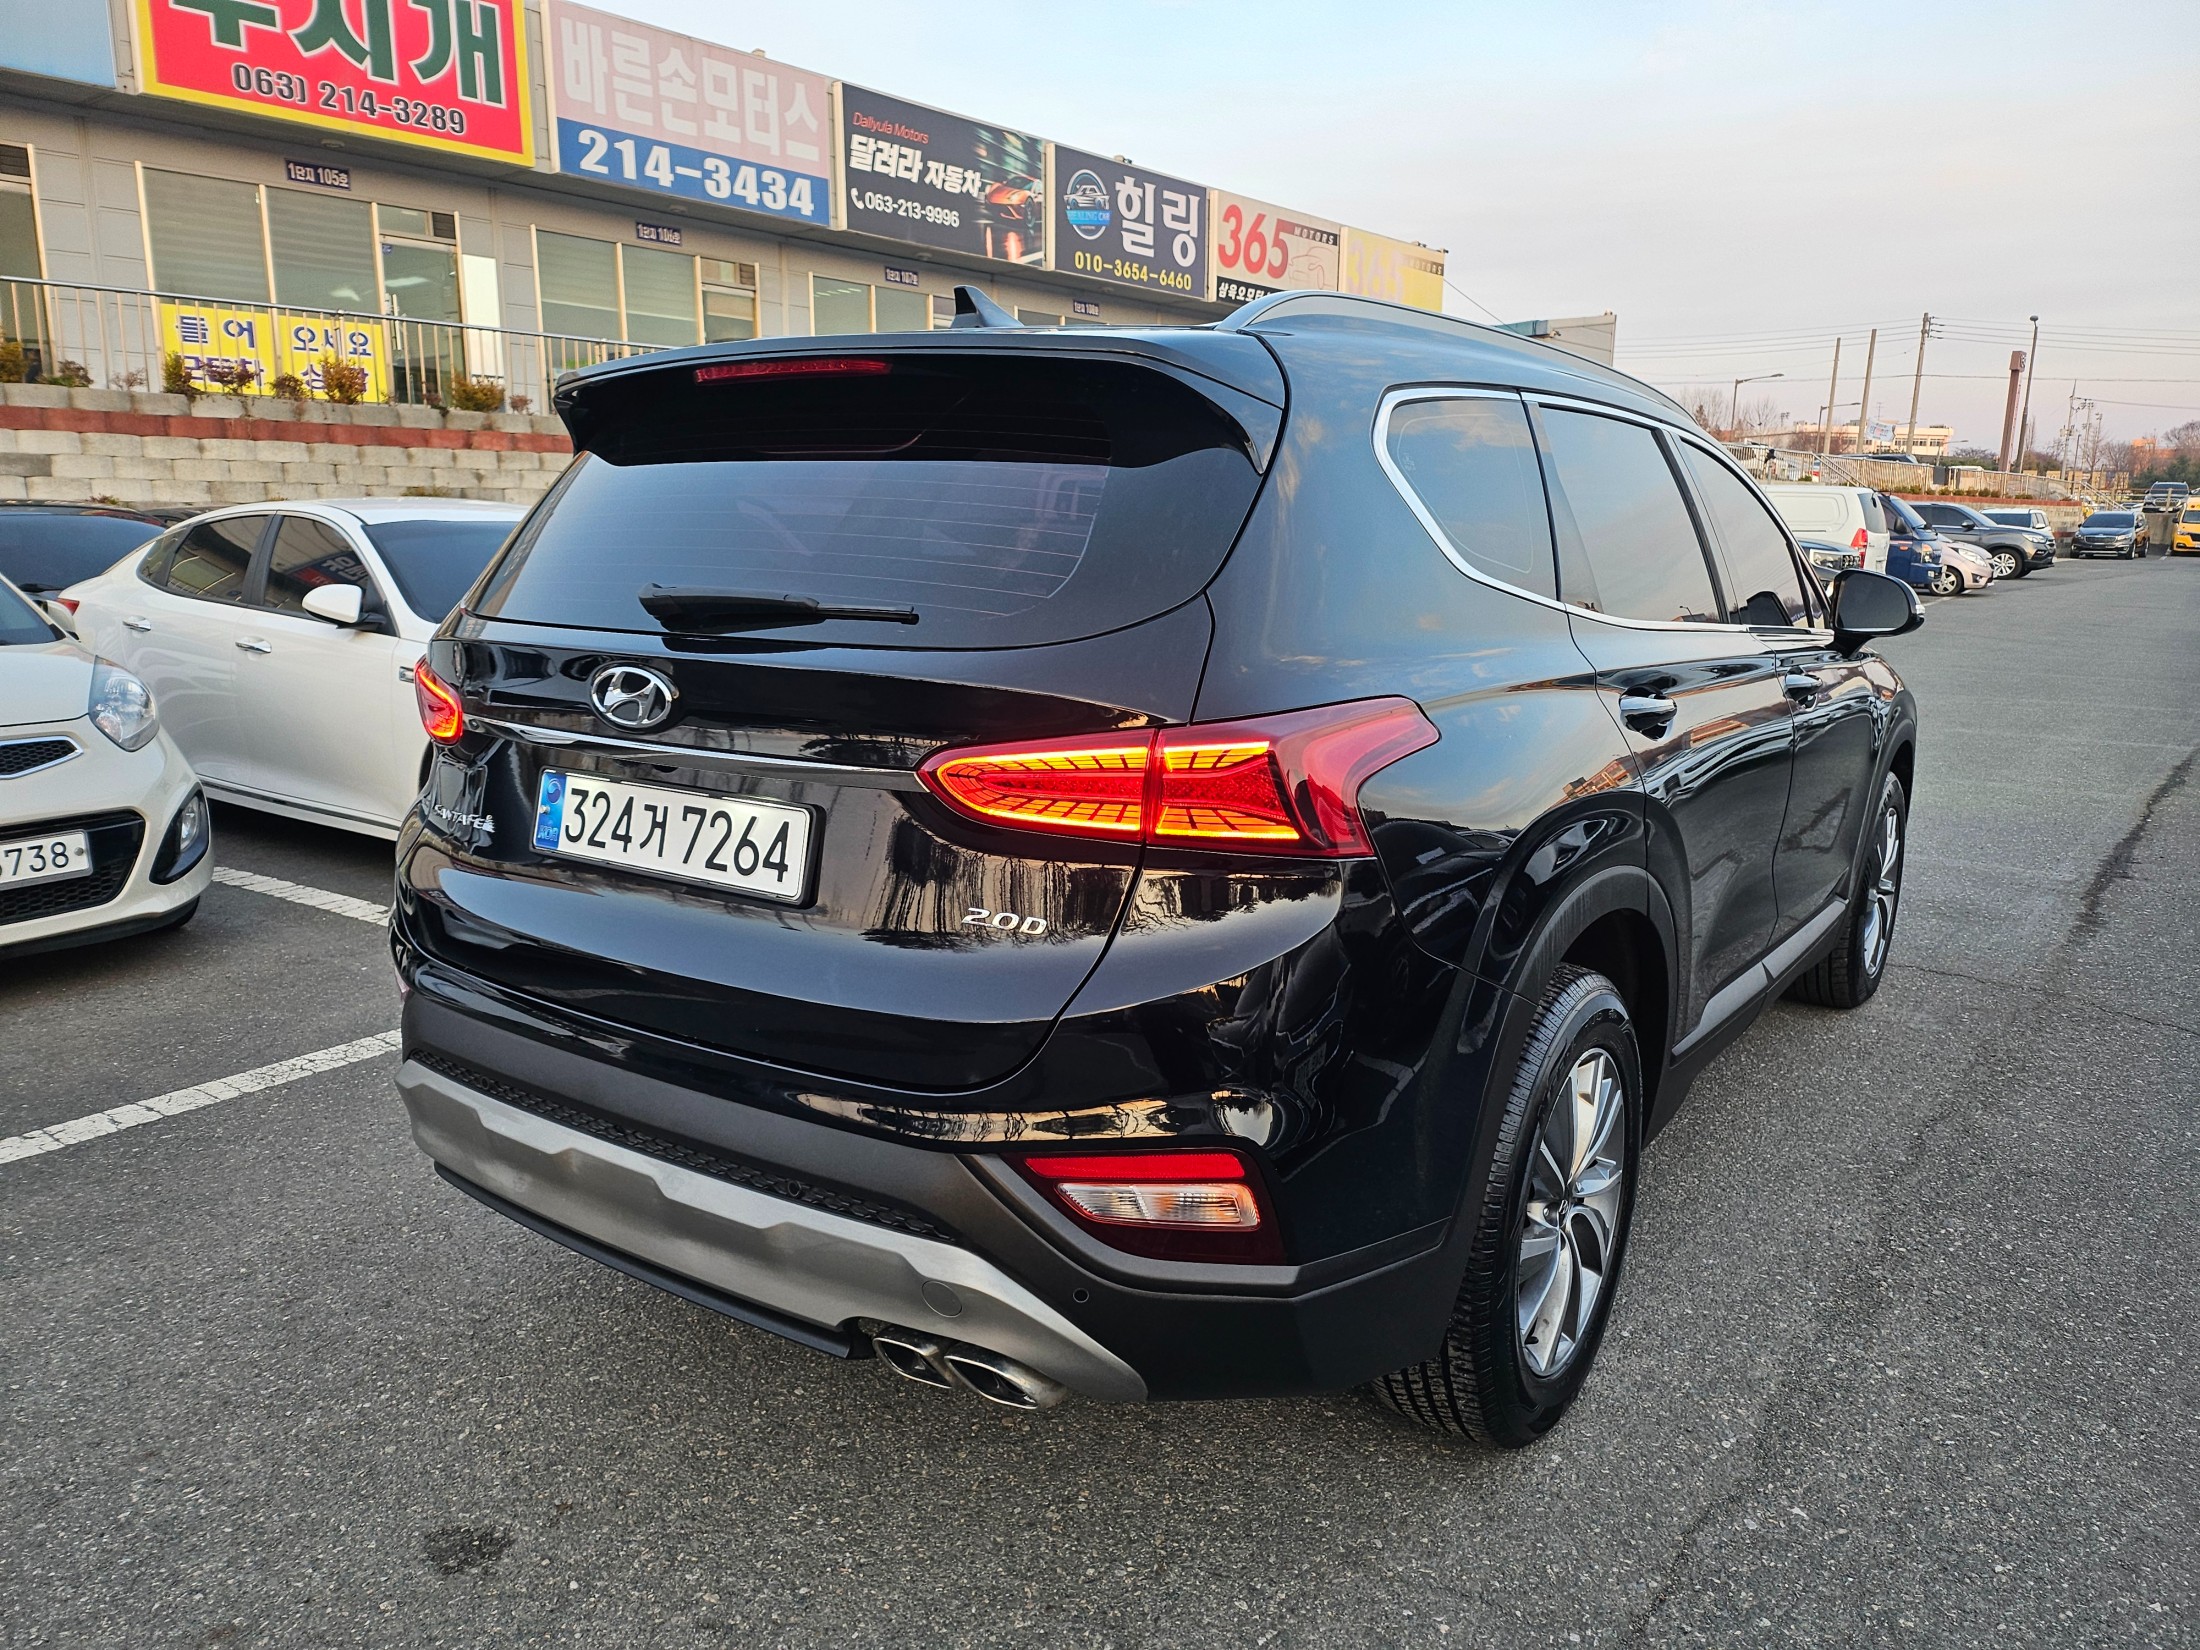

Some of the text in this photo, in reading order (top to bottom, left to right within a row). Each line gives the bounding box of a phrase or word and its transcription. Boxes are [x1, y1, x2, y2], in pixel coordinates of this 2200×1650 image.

[232, 63, 465, 134] 063) 214-3289
[559, 16, 820, 163] 바른손모터스
[849, 133, 982, 198] 달려라 자동차
[893, 122, 930, 145] Motors
[317, 167, 350, 188] 105호
[577, 129, 815, 217] 214-3434
[864, 191, 960, 228] 063-213-9996
[1115, 175, 1201, 268] 힐링
[1218, 204, 1335, 279] 365 MOTORS
[1074, 251, 1192, 291] 010-3654-6460
[1218, 281, 1271, 302] 삼육오모터
[0, 841, 69, 876] 738
[565, 787, 790, 883] 324거 7264
